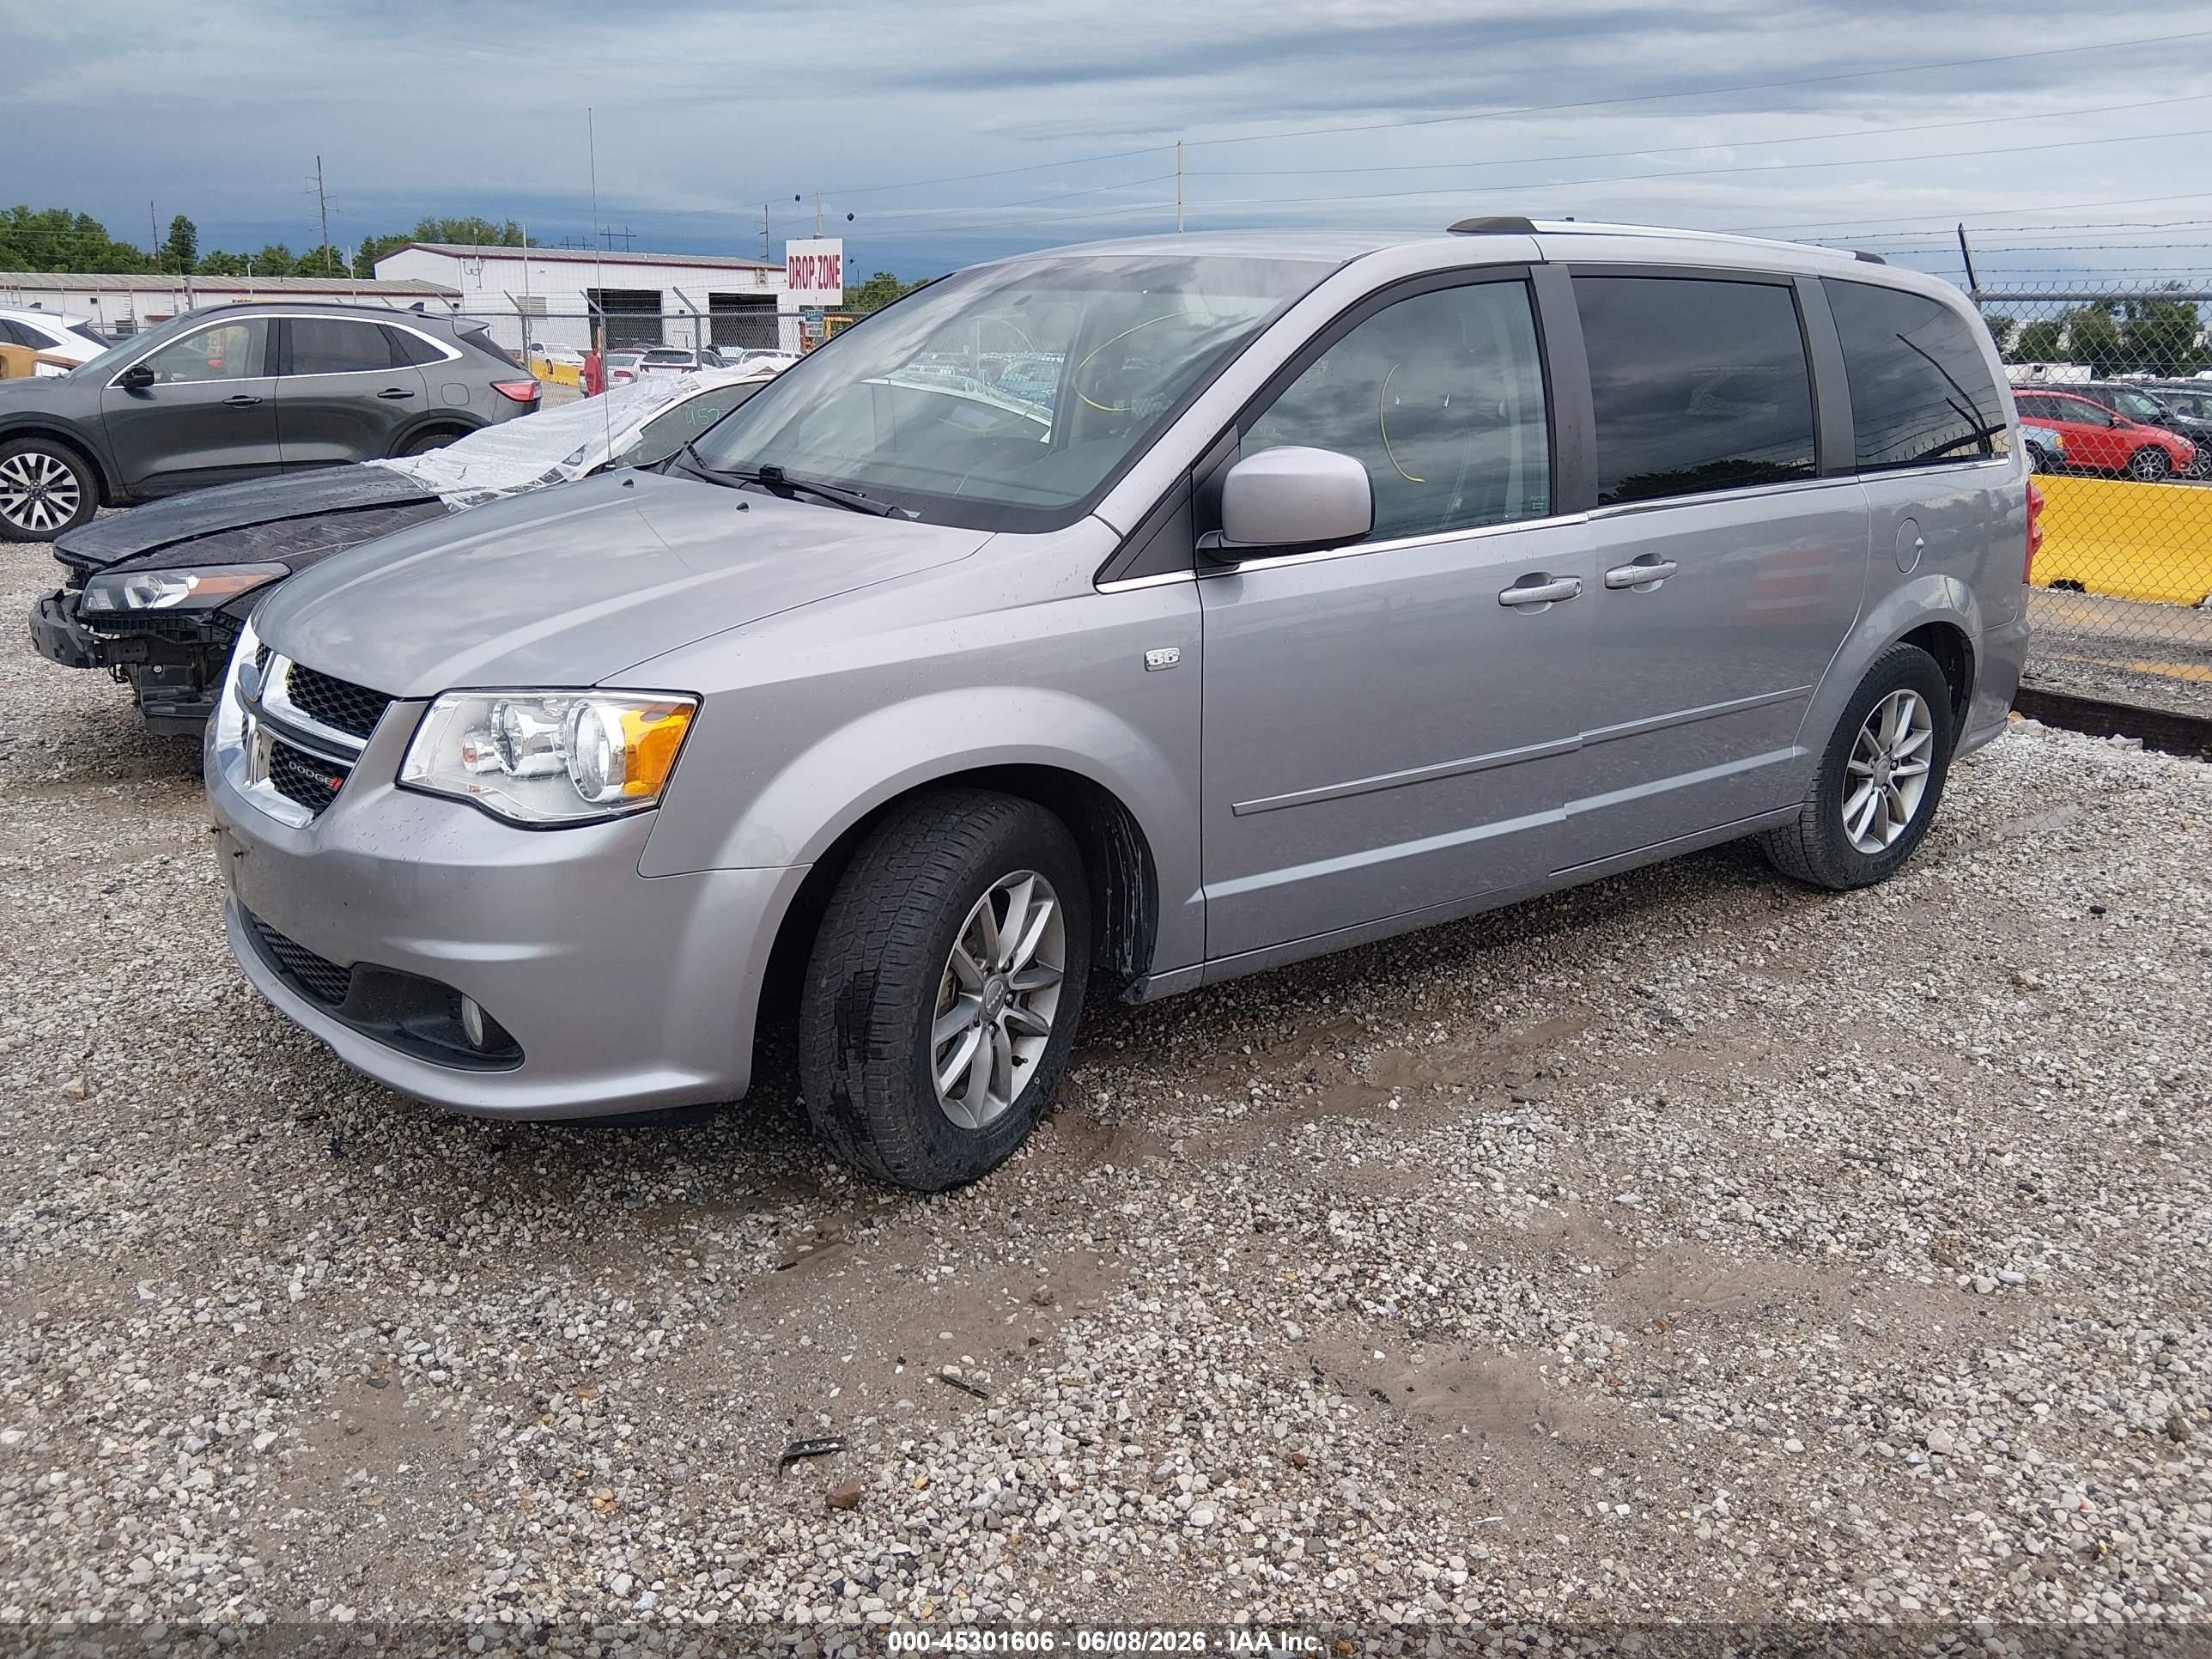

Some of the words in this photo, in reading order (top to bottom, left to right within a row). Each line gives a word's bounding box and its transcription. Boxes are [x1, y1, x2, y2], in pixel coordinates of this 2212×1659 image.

[788, 255, 815, 289] DROP
[817, 254, 841, 289] ZONE
[289, 761, 336, 787] DODGE
